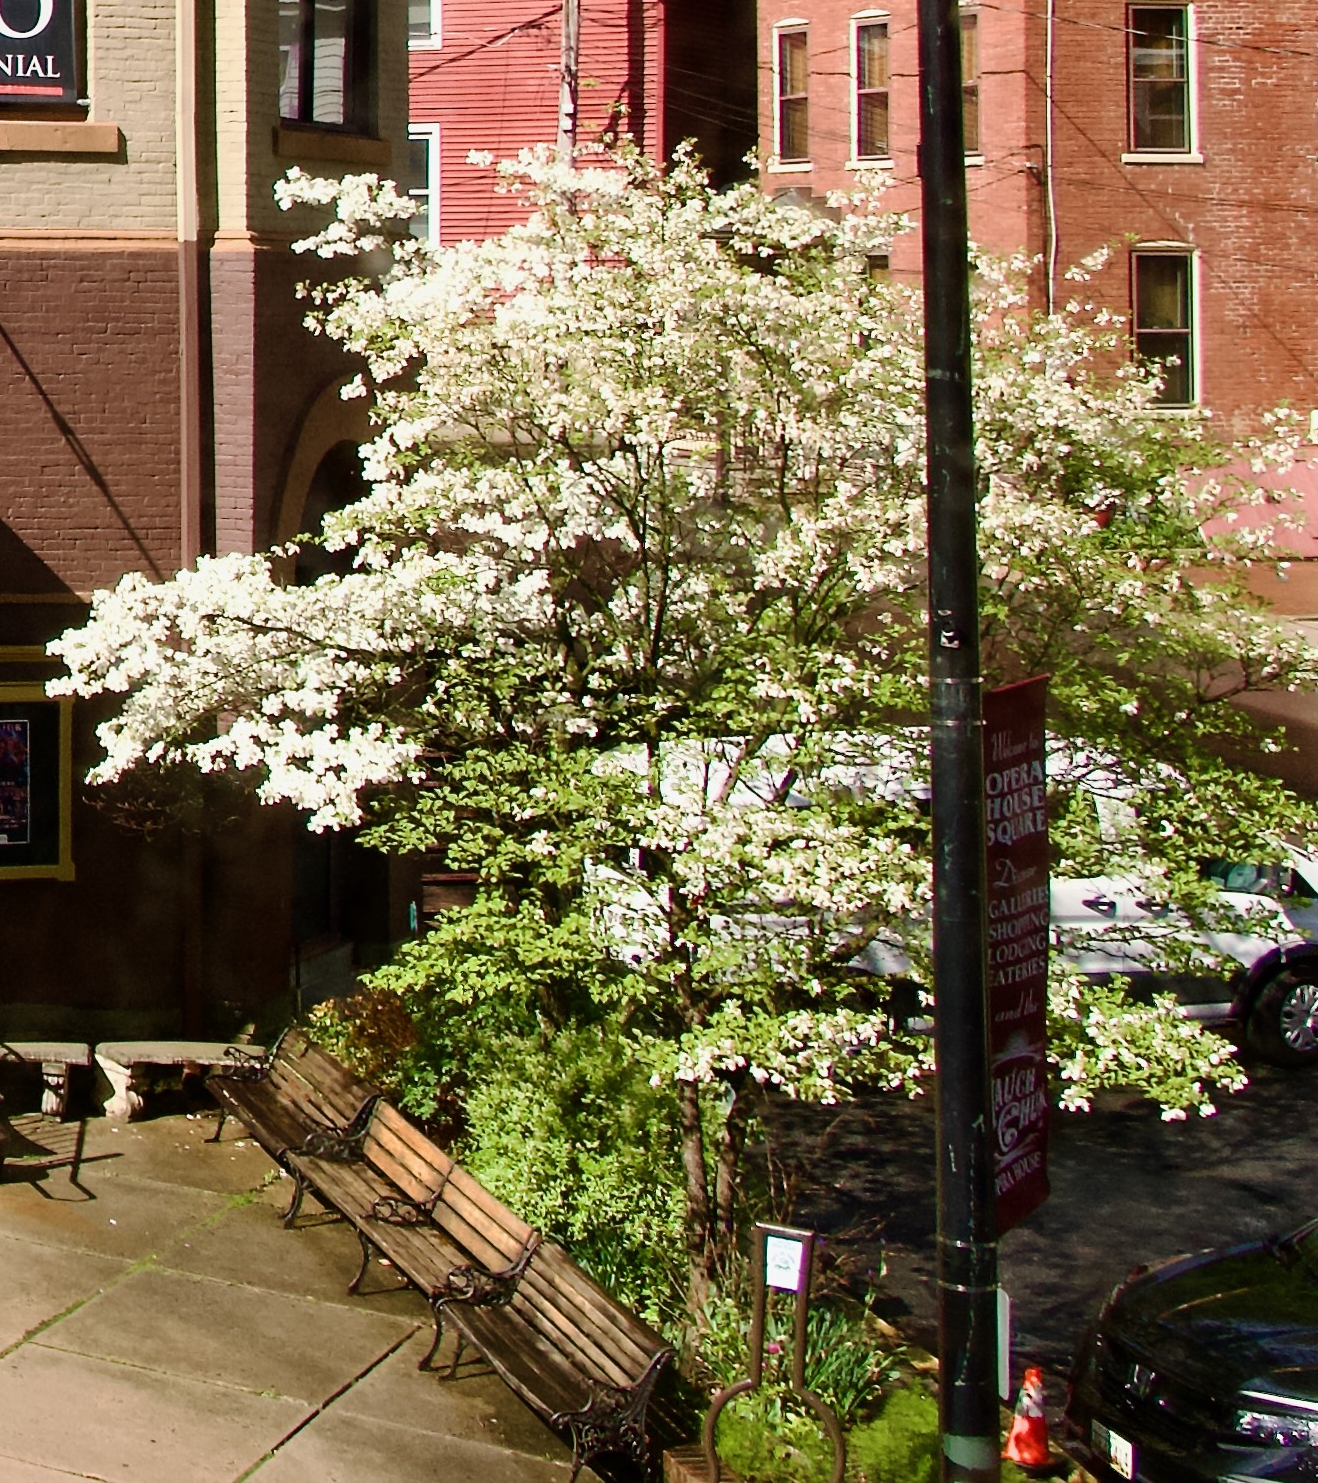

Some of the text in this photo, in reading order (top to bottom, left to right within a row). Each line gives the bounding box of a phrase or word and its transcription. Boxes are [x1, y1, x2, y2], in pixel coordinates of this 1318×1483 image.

[986, 760, 1043, 795] OPERA
[987, 785, 1045, 820] HOUSE
[986, 809, 1046, 846] SQUARE
